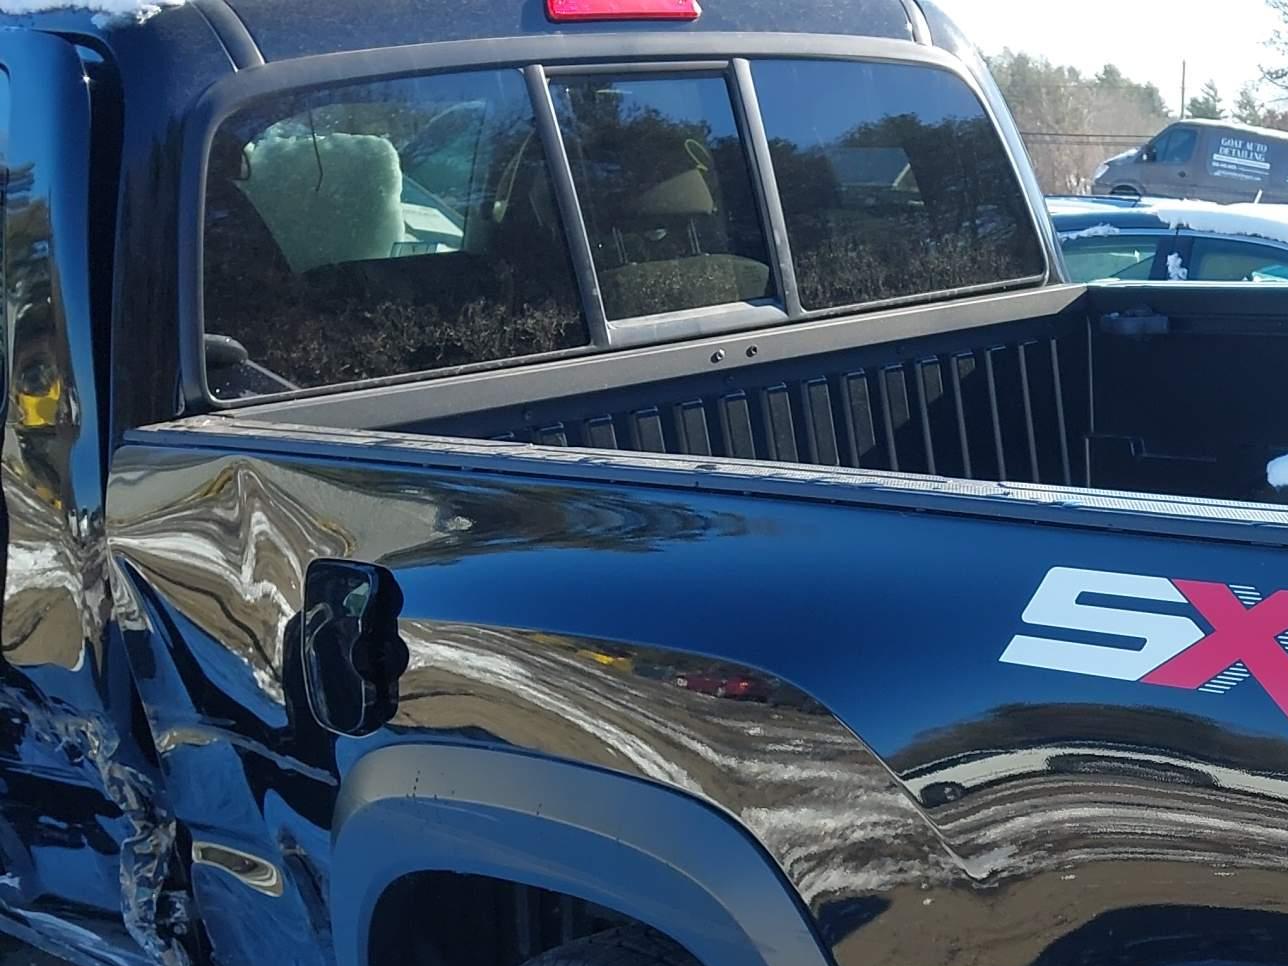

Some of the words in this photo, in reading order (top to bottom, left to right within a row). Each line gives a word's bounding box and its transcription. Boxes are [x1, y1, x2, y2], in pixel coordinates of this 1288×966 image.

[1220, 137, 1243, 149] GOAT
[1246, 142, 1268, 153] AUTO
[1219, 146, 1265, 162] DETAILING
